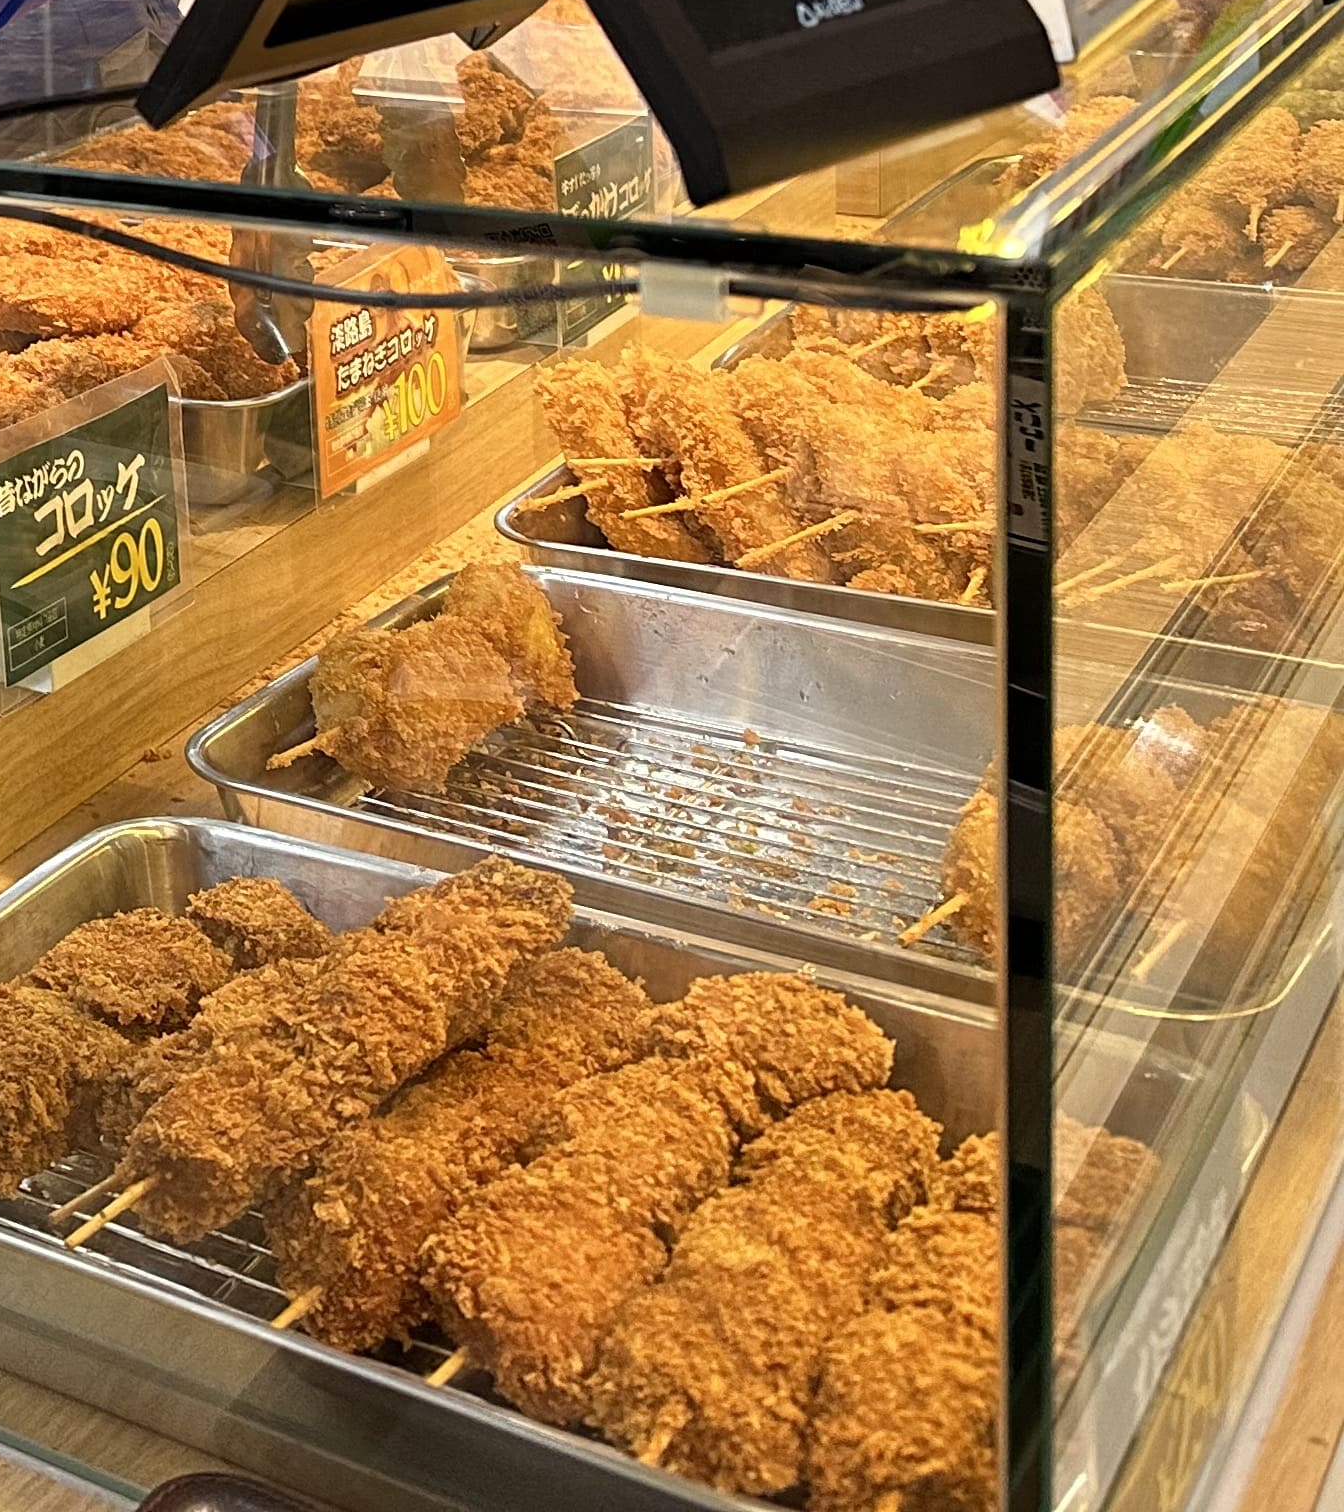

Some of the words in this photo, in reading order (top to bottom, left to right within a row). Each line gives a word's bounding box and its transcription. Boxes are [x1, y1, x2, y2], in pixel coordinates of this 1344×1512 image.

[330, 308, 374, 355] 淡路島
[336, 315, 438, 392] たまねぎコロッケ
[383, 352, 448, 441] ¥100
[34, 453, 146, 556] コロッケ
[89, 517, 164, 619] ¥90
